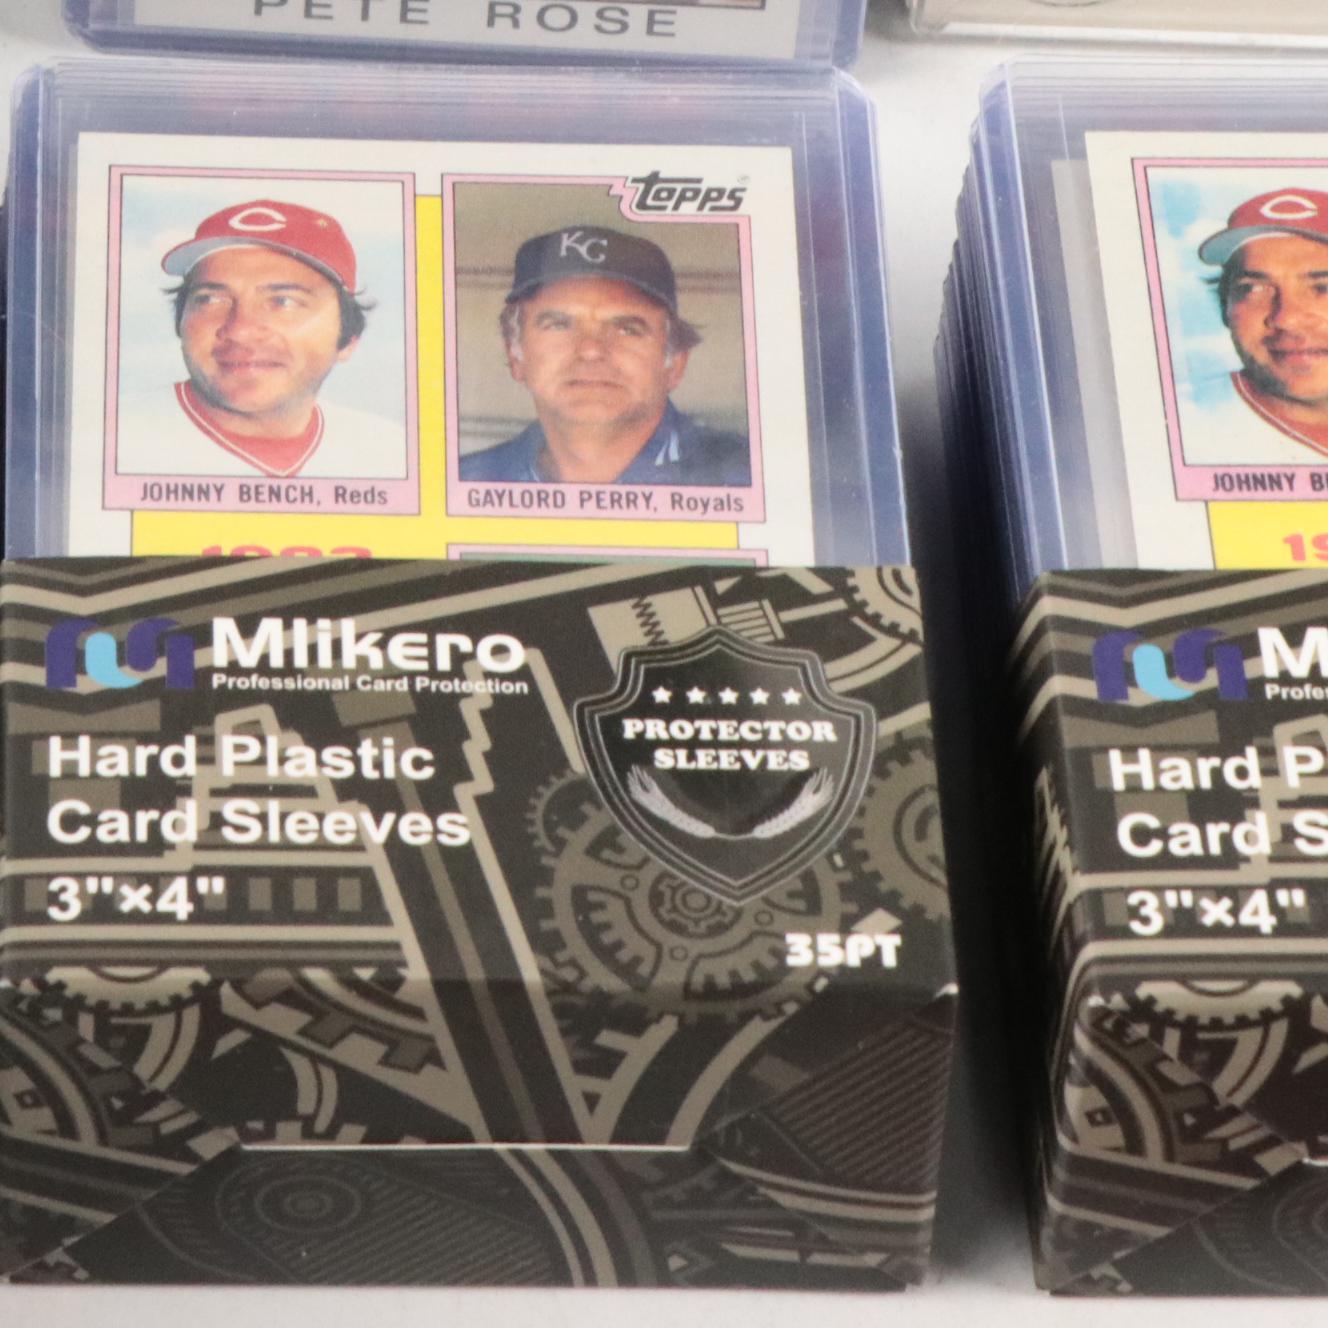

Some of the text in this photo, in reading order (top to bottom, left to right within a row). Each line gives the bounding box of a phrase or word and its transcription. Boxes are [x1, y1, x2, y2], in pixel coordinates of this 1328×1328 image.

[486, 0, 678, 39] ROSE
[140, 482, 388, 506] JOHNNY BENCH, Reds
[1213, 472, 1295, 492] JOHNNY
[467, 488, 744, 515] GAYLORD PERRY, Royals
[212, 616, 525, 673] Mlikero
[212, 673, 529, 696] Professional Card Protection
[622, 718, 837, 742] PROTECTOR
[47, 734, 435, 781] Hard Plastic
[654, 749, 810, 772] SLEEVES
[1108, 746, 1262, 791] Hard
[47, 798, 470, 846] Card Sleeves
[1117, 811, 1271, 858] Card
[785, 932, 901, 968] 35PT
